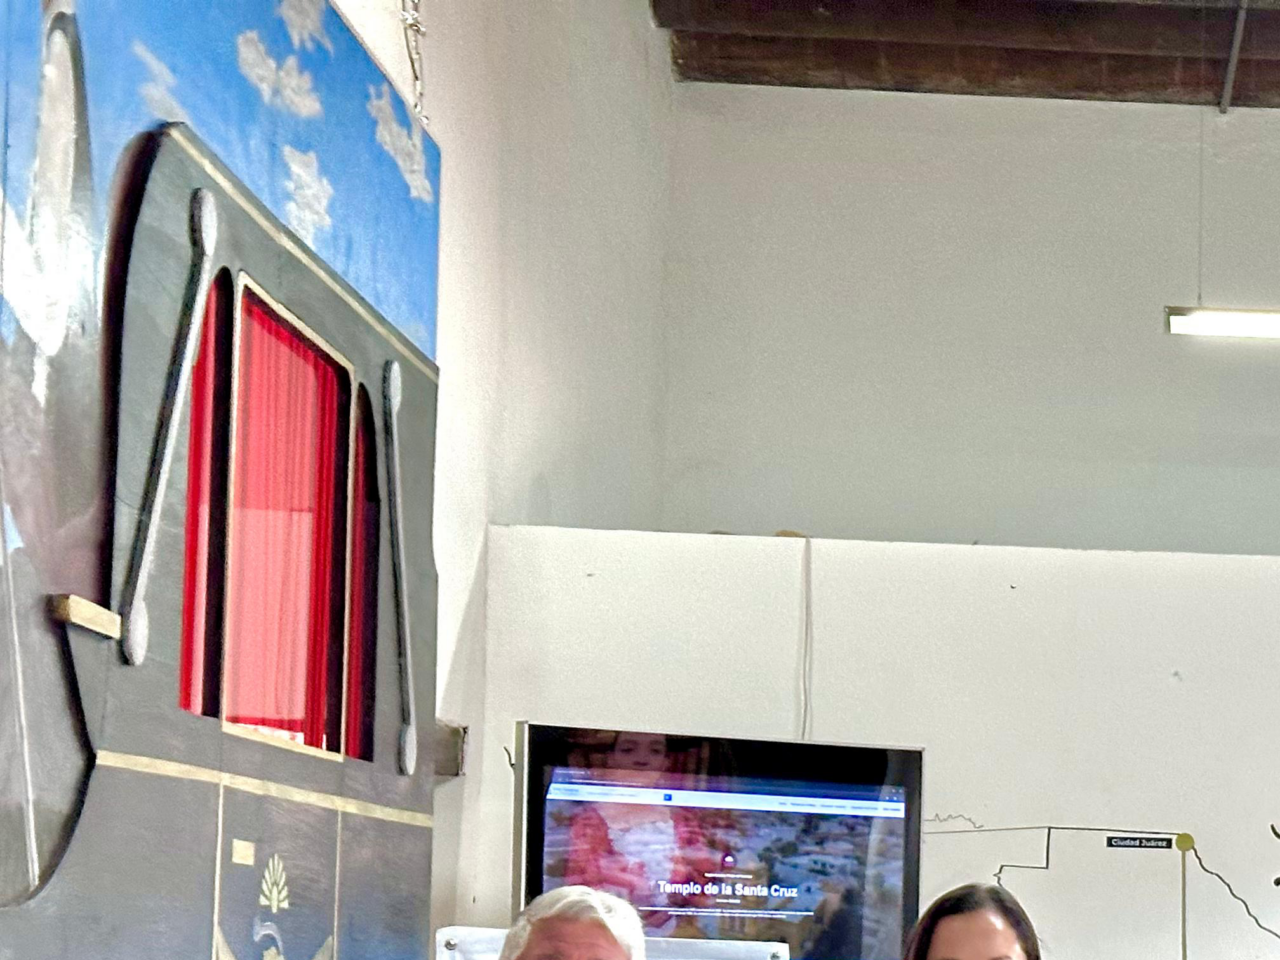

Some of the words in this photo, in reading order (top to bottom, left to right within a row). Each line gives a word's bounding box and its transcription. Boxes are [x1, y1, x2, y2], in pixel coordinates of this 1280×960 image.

[1111, 838, 1139, 847] Ciudad
[1141, 839, 1168, 847] Juárez
[657, 881, 702, 897] Templo
[704, 882, 718, 895] de
[721, 883, 732, 896] la
[735, 883, 768, 896] Santa
[770, 884, 798, 897] Cruz
